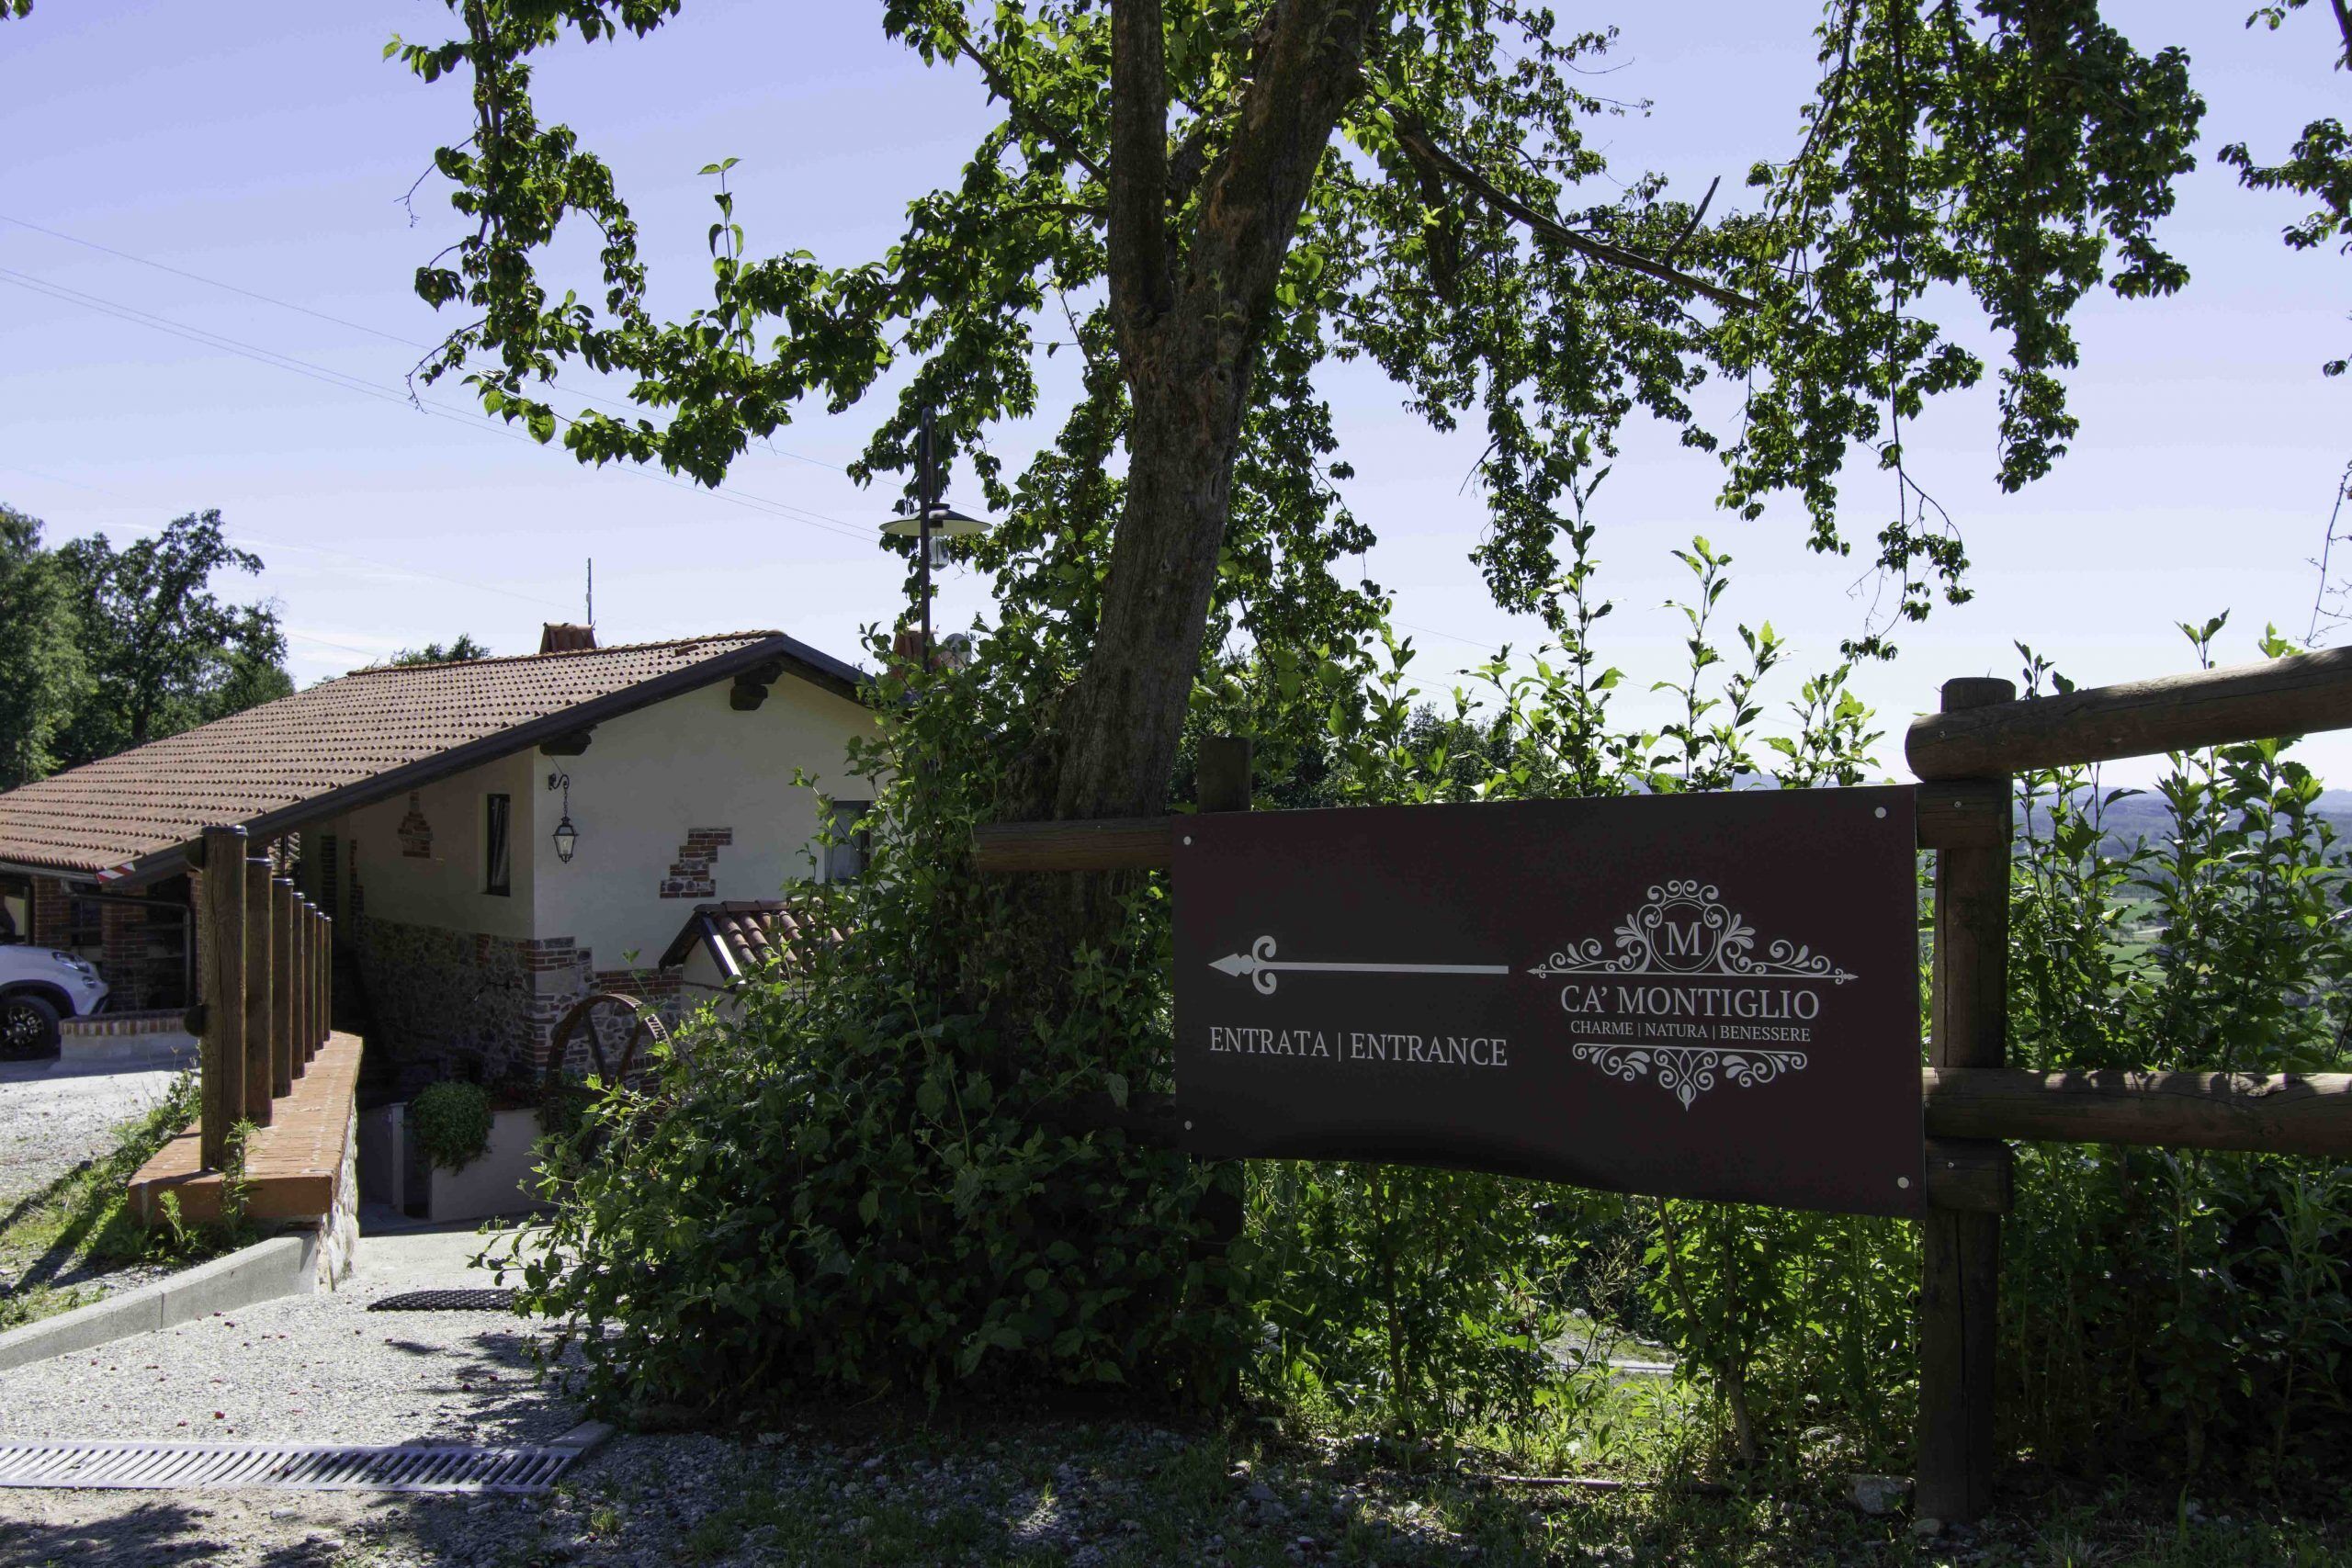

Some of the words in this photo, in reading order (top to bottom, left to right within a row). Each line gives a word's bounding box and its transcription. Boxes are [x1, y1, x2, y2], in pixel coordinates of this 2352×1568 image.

[1664, 921, 1703, 956] M
[1560, 985, 1608, 1013] CA'
[1616, 986, 1820, 1020] MONTIGLIO
[1209, 1026, 1330, 1057] ENTRATA
[1350, 1032, 1508, 1066] ENTRANCE
[1570, 1020, 1634, 1036] CHARME
[1645, 1022, 1709, 1039] NATURA
[1719, 1025, 1811, 1043] BENESSERE
